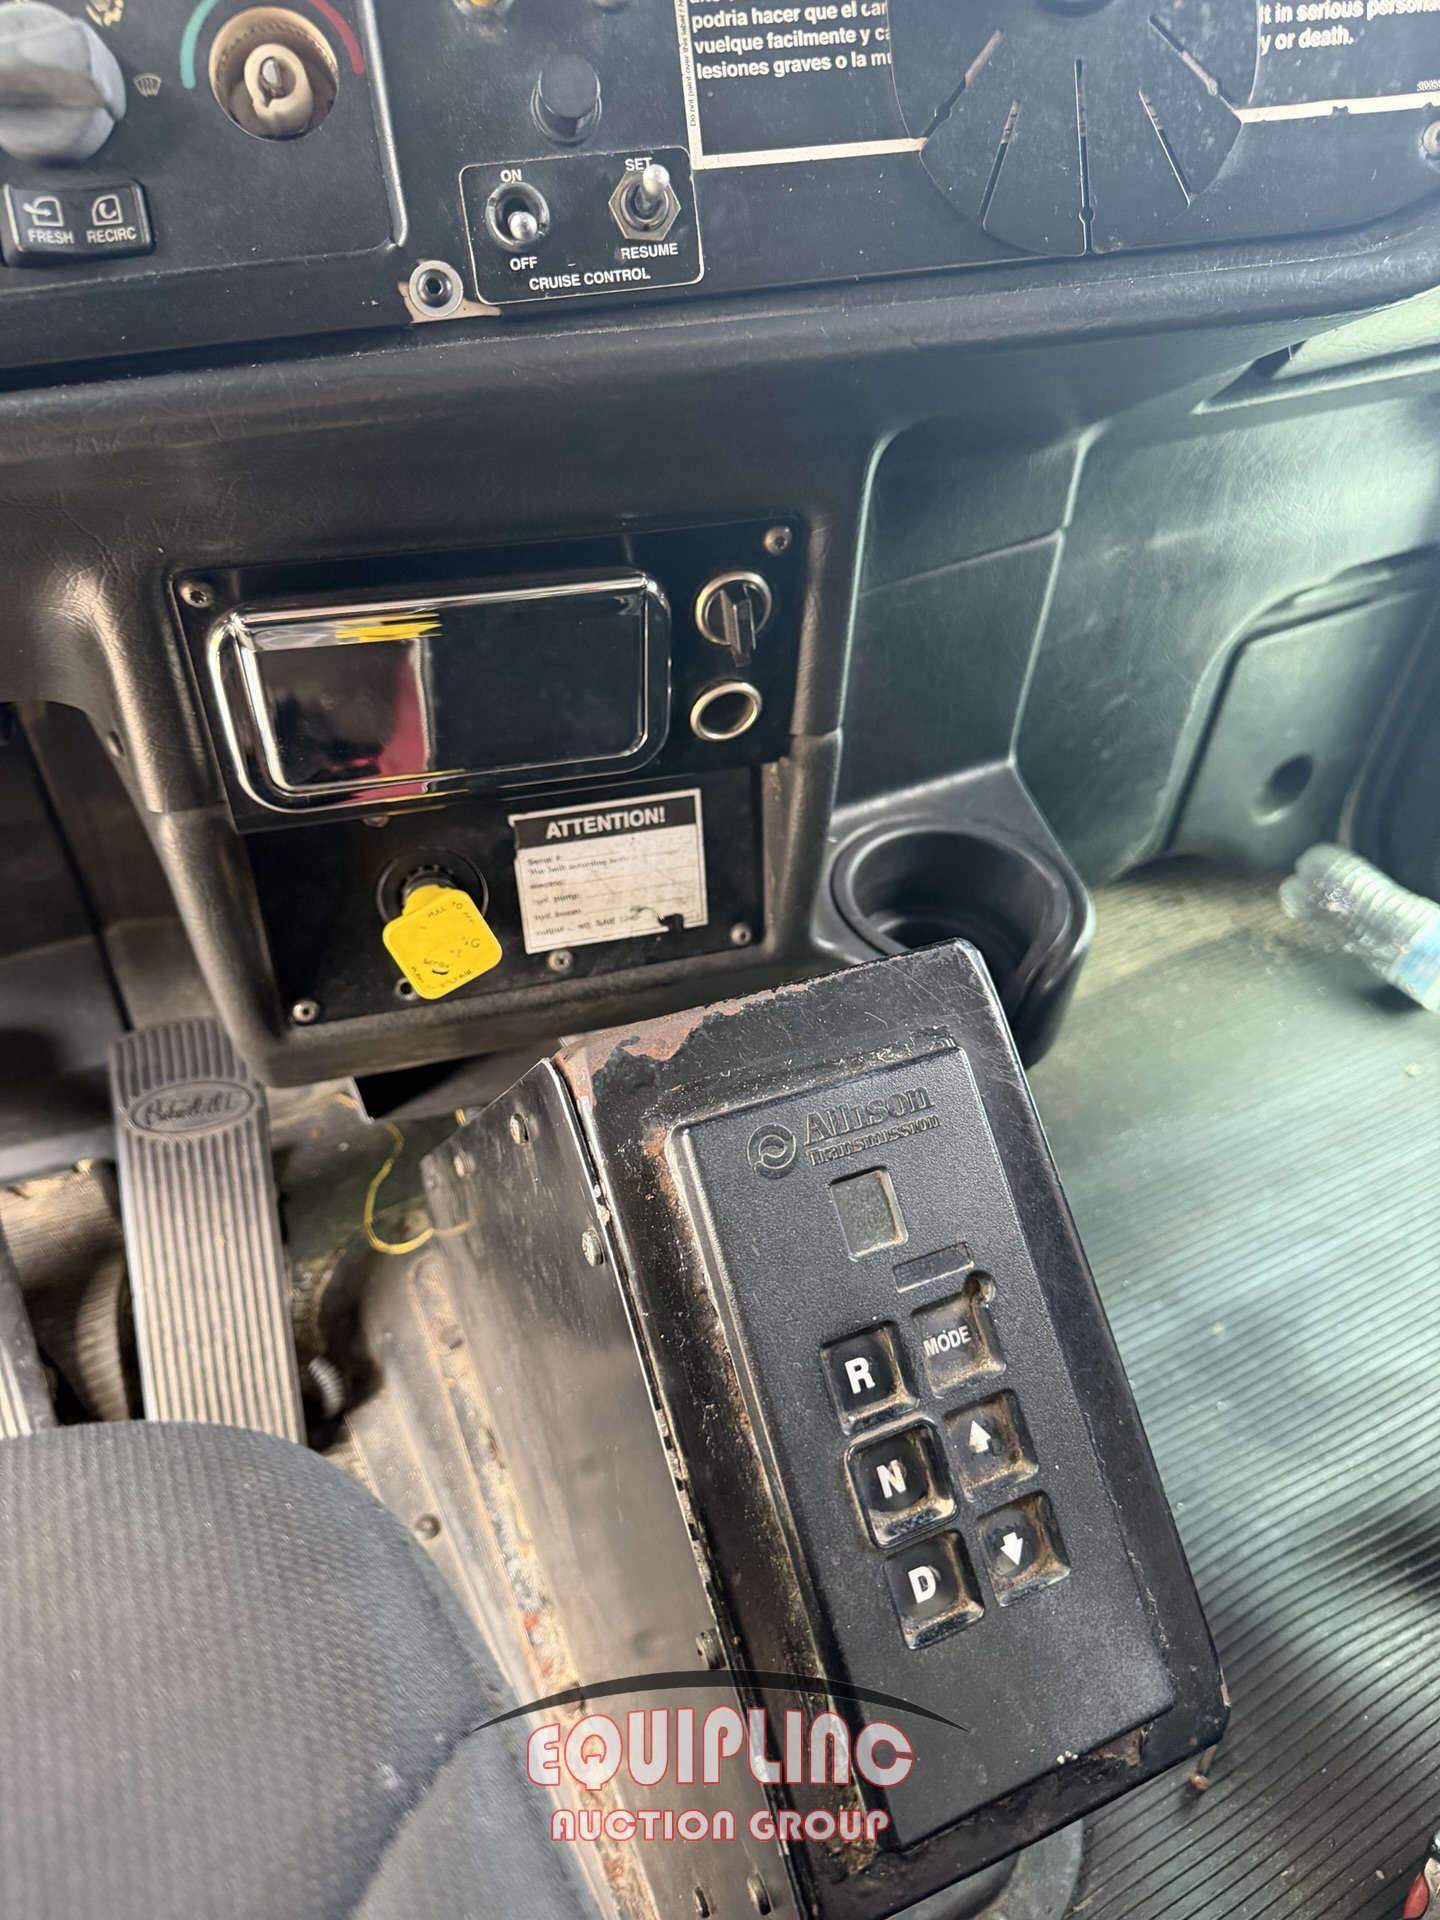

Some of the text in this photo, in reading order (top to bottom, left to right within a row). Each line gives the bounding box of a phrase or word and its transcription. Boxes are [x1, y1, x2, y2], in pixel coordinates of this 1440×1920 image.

[691, 9, 749, 34] podria
[751, 7, 801, 26] hacer
[804, 7, 838, 26] que
[841, 1, 858, 18] el
[1275, 2, 1293, 24] in
[1296, 0, 1364, 22] serious
[682, 37, 690, 53] this
[694, 35, 764, 56] vuelque
[766, 28, 857, 50] facilmente
[859, 28, 871, 47] y
[1274, 32, 1296, 51] or
[1298, 24, 1355, 49] death.
[684, 55, 692, 74] over
[696, 60, 769, 80] lesiones
[773, 55, 832, 78] graves
[835, 56, 848, 70] o
[851, 50, 868, 68] la
[685, 76, 695, 97] paint
[688, 99, 696, 112] not
[689, 114, 697, 126] Do
[500, 169, 523, 183] ON
[625, 157, 653, 172] SET
[27, 228, 75, 245] FRESH
[85, 226, 138, 244] RECIRC
[509, 256, 538, 271] OFF
[620, 243, 679, 260] RESUME
[529, 267, 651, 291] CRUISE CONTROL
[545, 805, 666, 840] ATTENTION!
[803, 1086, 935, 1147] Allison
[804, 1113, 942, 1167] Transmission
[923, 1324, 973, 1357] MODE
[844, 1356, 876, 1395] R
[876, 1459, 907, 1499] N
[907, 1565, 938, 1604] D
